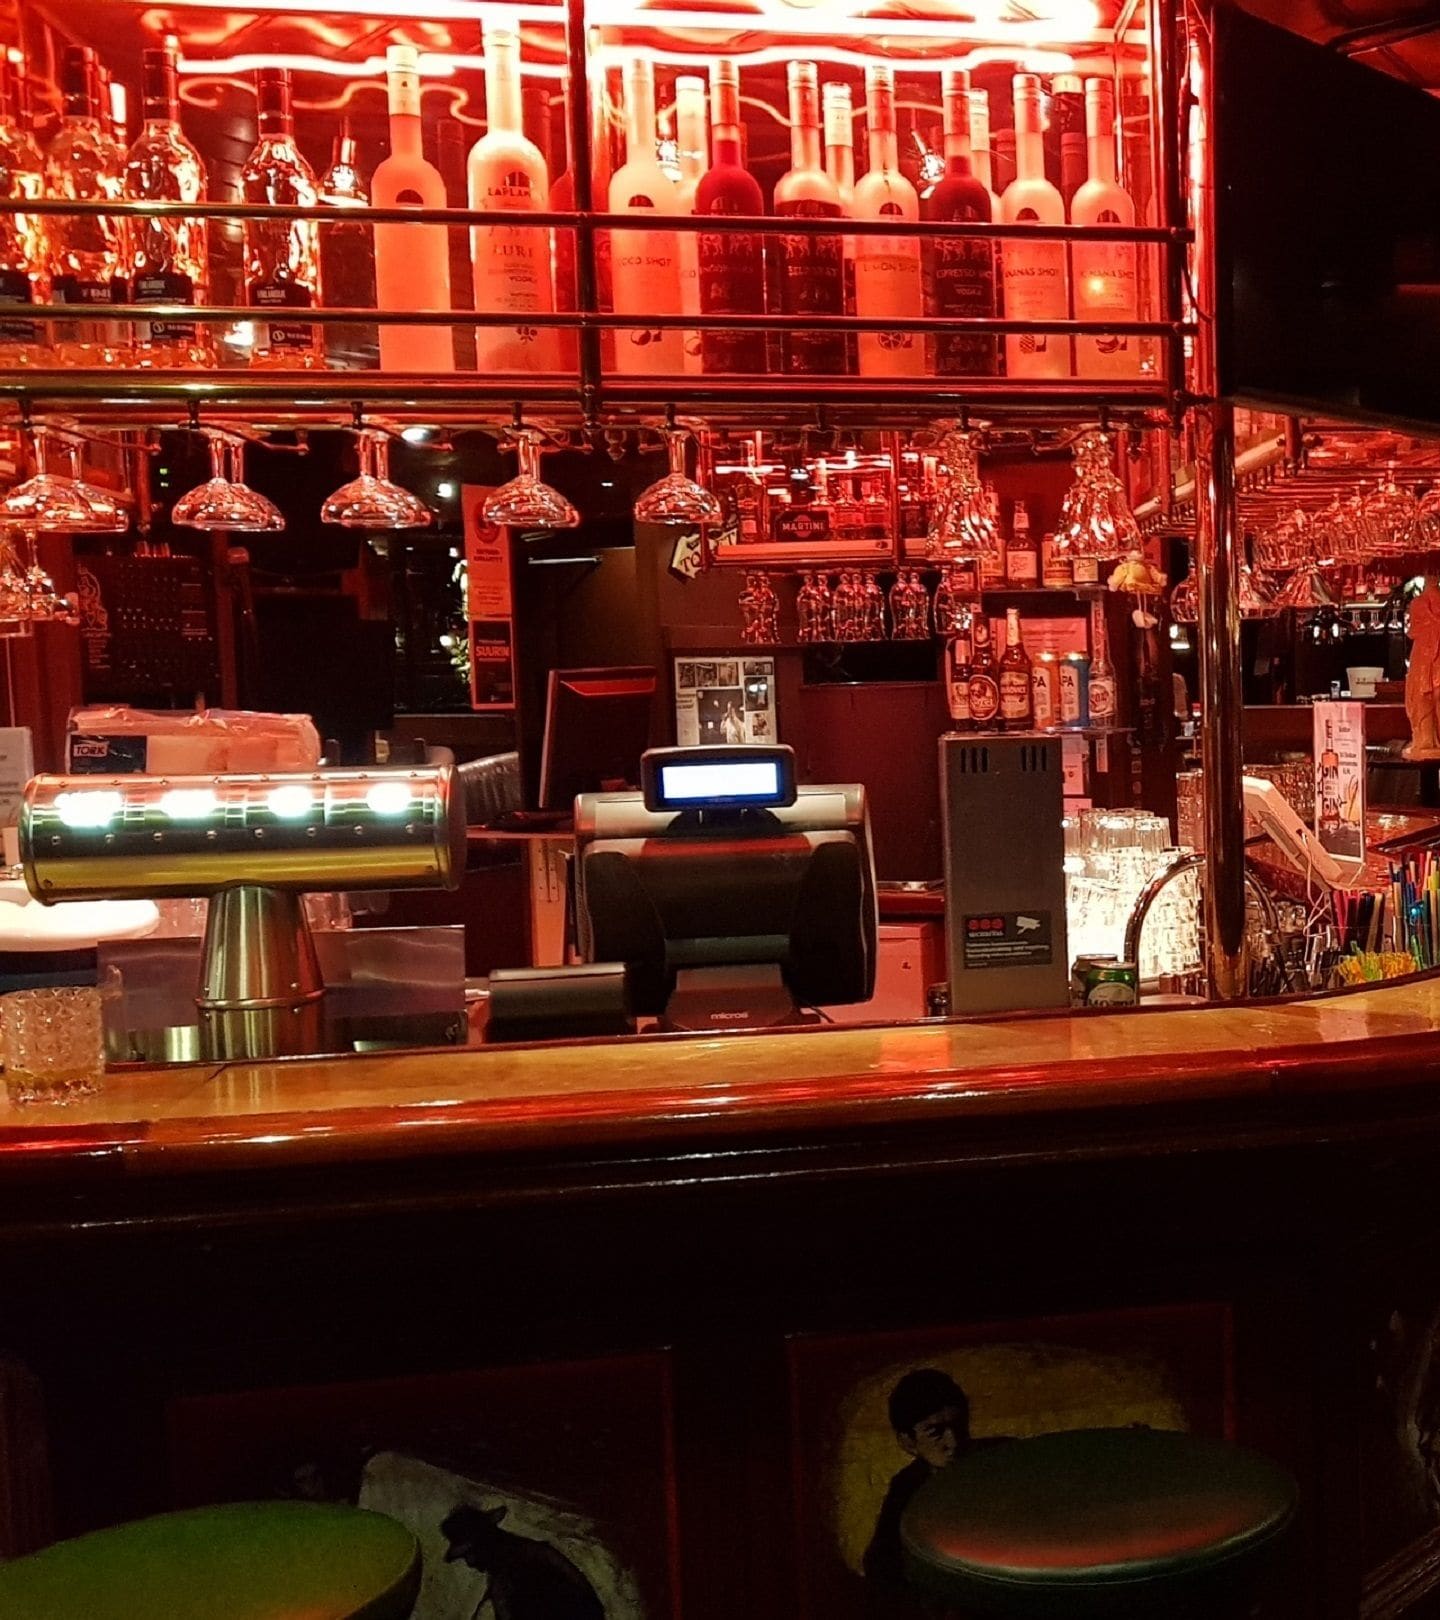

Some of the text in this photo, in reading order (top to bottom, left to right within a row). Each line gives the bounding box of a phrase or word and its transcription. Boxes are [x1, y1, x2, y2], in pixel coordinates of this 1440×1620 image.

[487, 186, 533, 197] LAPLAN
[782, 521, 825, 532] MARTINI
[76, 746, 106, 756] TORK
[710, 1011, 750, 1021] micros
